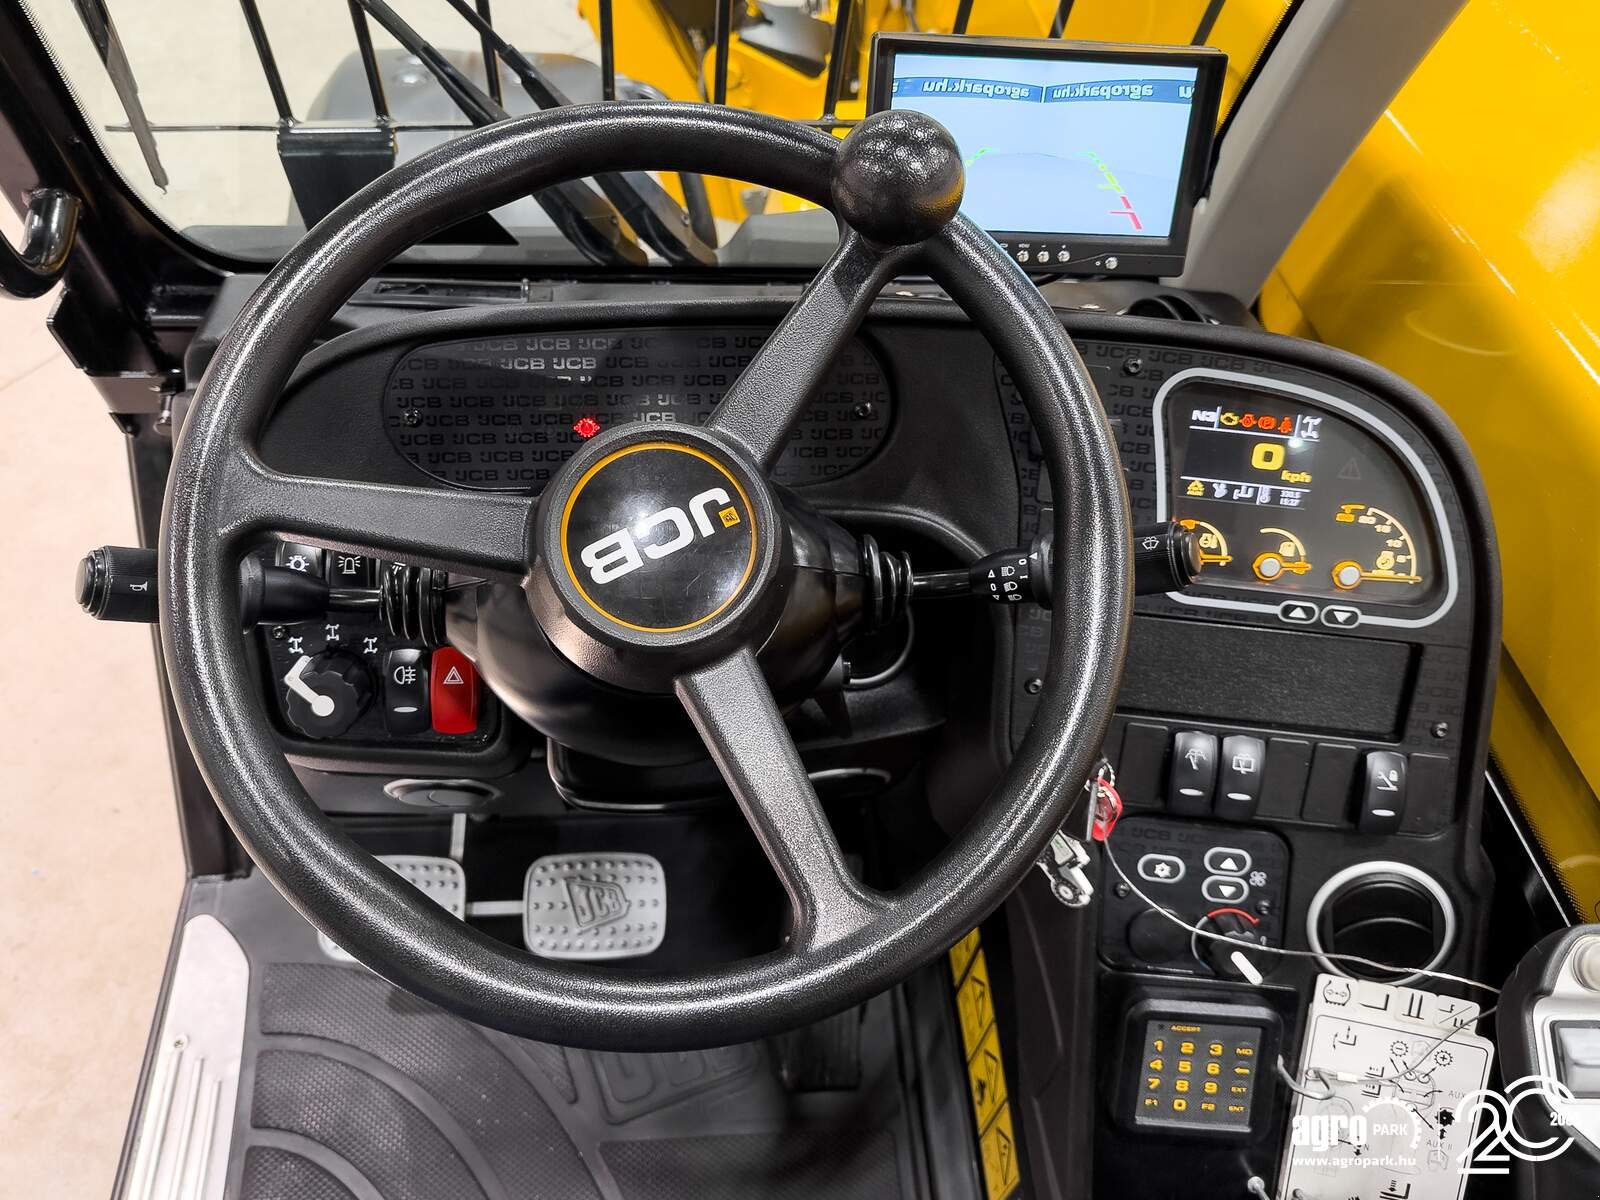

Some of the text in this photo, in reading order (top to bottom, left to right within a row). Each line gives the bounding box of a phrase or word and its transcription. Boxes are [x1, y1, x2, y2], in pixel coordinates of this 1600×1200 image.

[526, 338, 570, 350] JCB
[696, 336, 726, 348] CB
[501, 357, 545, 370] JCB
[553, 357, 597, 370] JCB
[684, 374, 726, 387] JCB
[397, 396, 441, 409] JCB
[450, 395, 494, 408] JCB
[426, 415, 470, 428] JCB
[478, 414, 522, 427] JCB
[400, 434, 444, 446] JCB
[453, 433, 497, 446] JCB
[505, 432, 549, 445] JCB
[428, 451, 472, 464] JCB
[480, 451, 524, 463] JCB
[1252, 442, 1285, 471] 0
[455, 470, 499, 482] JCB
[507, 469, 550, 482] JCB
[580, 487, 741, 585] JCB
[1153, 1039, 1164, 1052] 1
[1180, 1041, 1195, 1055] 2
[1209, 1043, 1223, 1056] 3
[1149, 1058, 1220, 1076] 4 5 6
[1147, 1077, 1161, 1089] 7
[1175, 1079, 1189, 1092] 8
[1203, 1081, 1218, 1095] 9
[1172, 1098, 1187, 1111] 0
